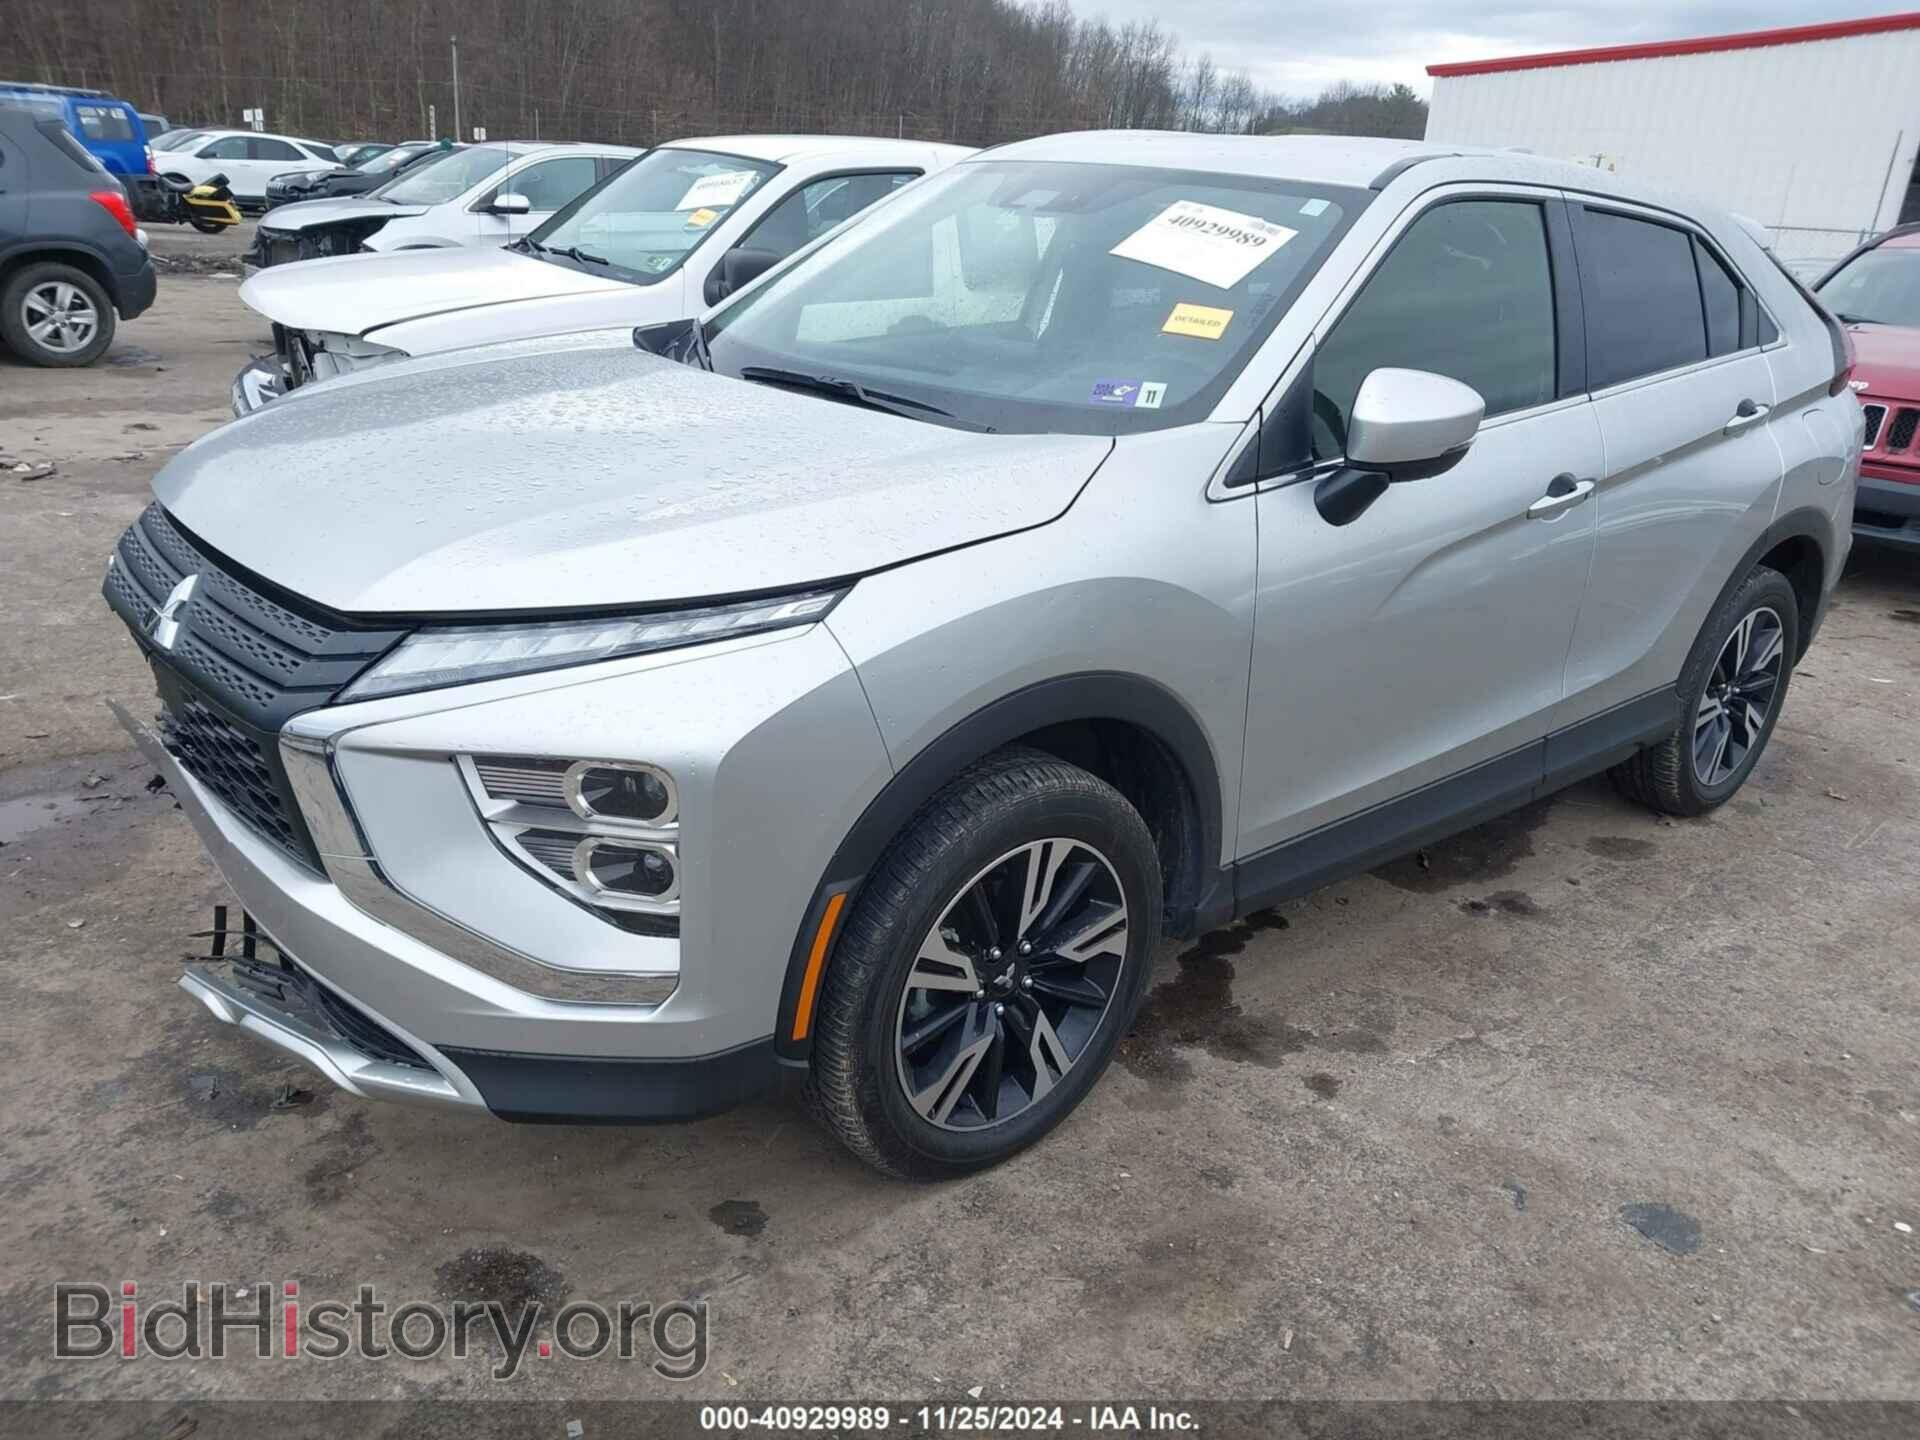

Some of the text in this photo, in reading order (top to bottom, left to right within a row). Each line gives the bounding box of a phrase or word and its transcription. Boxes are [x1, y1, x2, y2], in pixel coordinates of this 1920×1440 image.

[1168, 215, 1267, 247] 40929989
[1174, 314, 1222, 328] DETAILED
[1145, 389, 1157, 404] 11
